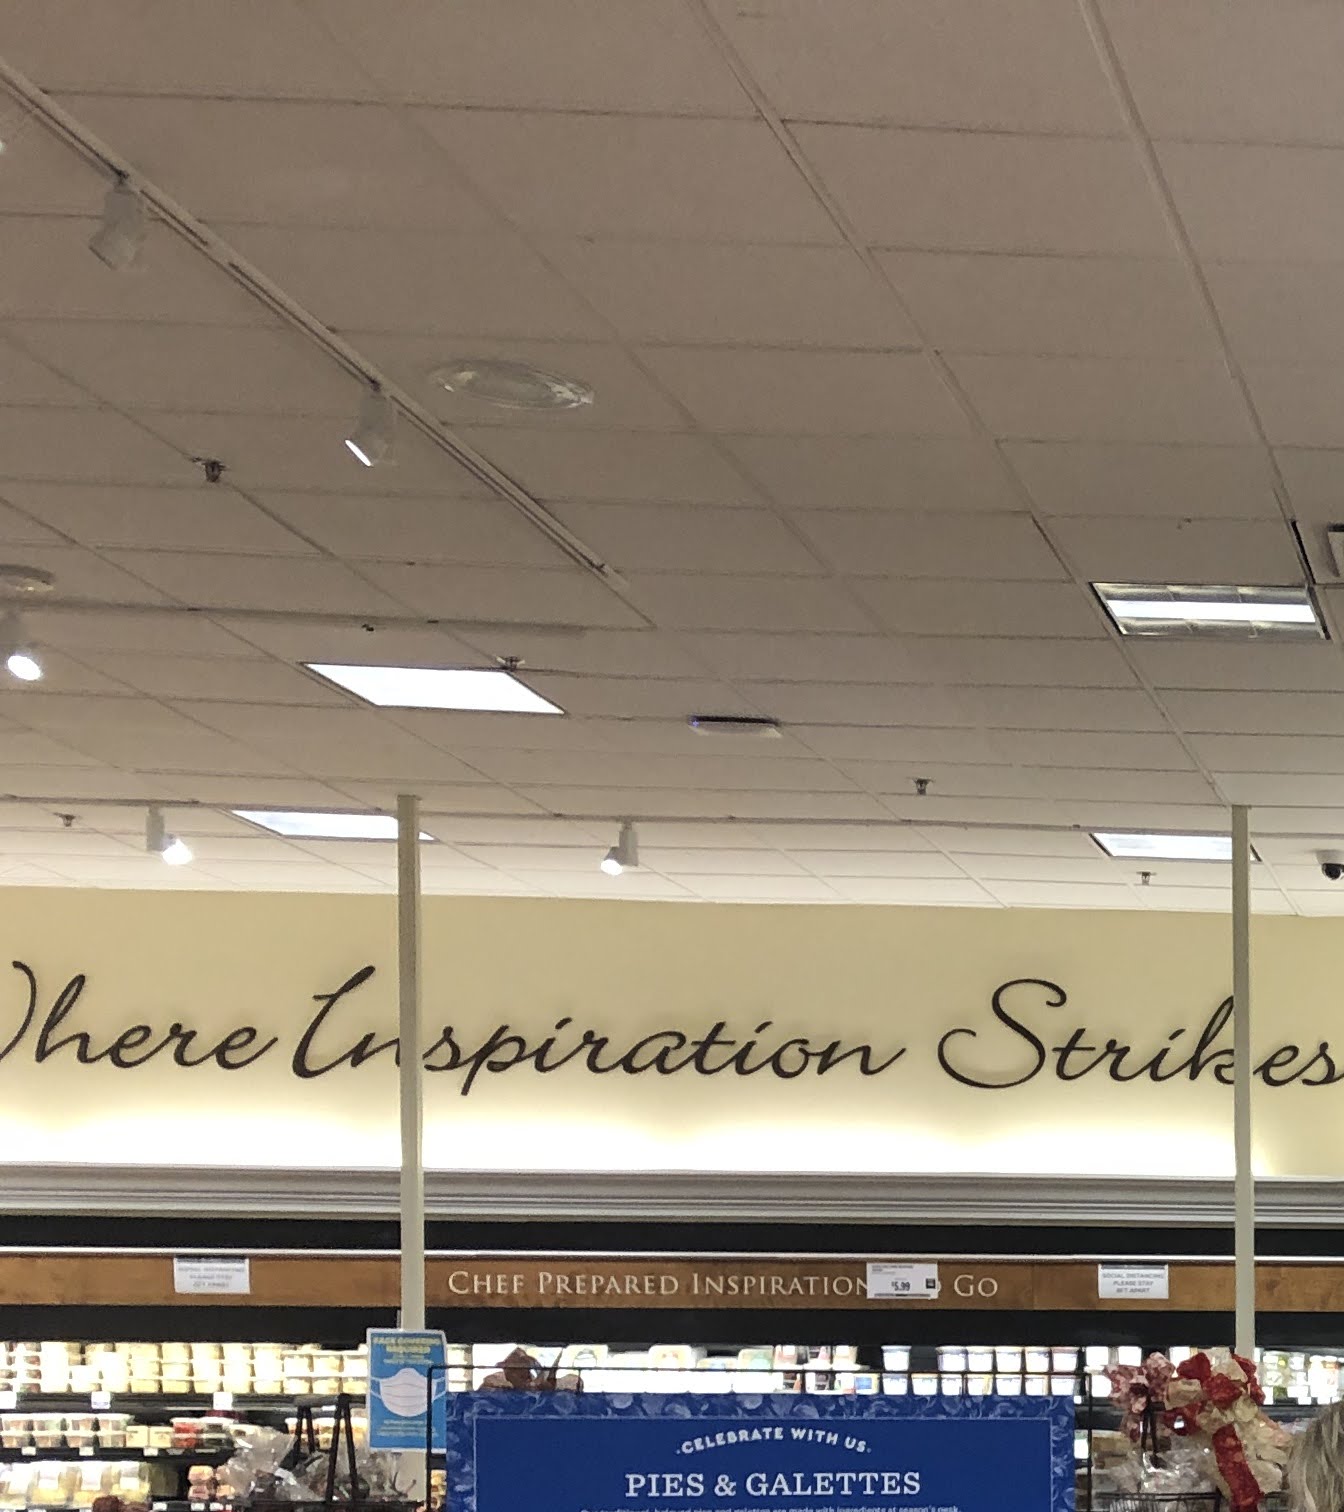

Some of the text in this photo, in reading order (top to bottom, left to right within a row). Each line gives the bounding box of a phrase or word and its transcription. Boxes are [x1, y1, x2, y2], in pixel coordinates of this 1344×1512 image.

[292, 965, 906, 1097] Inspiration
[538, 1271, 680, 1296] PREPARED
[680, 1427, 785, 1455] CELEBRATE
[790, 1427, 839, 1446] WITH
[625, 1471, 921, 1498] PIES & GALETTES
